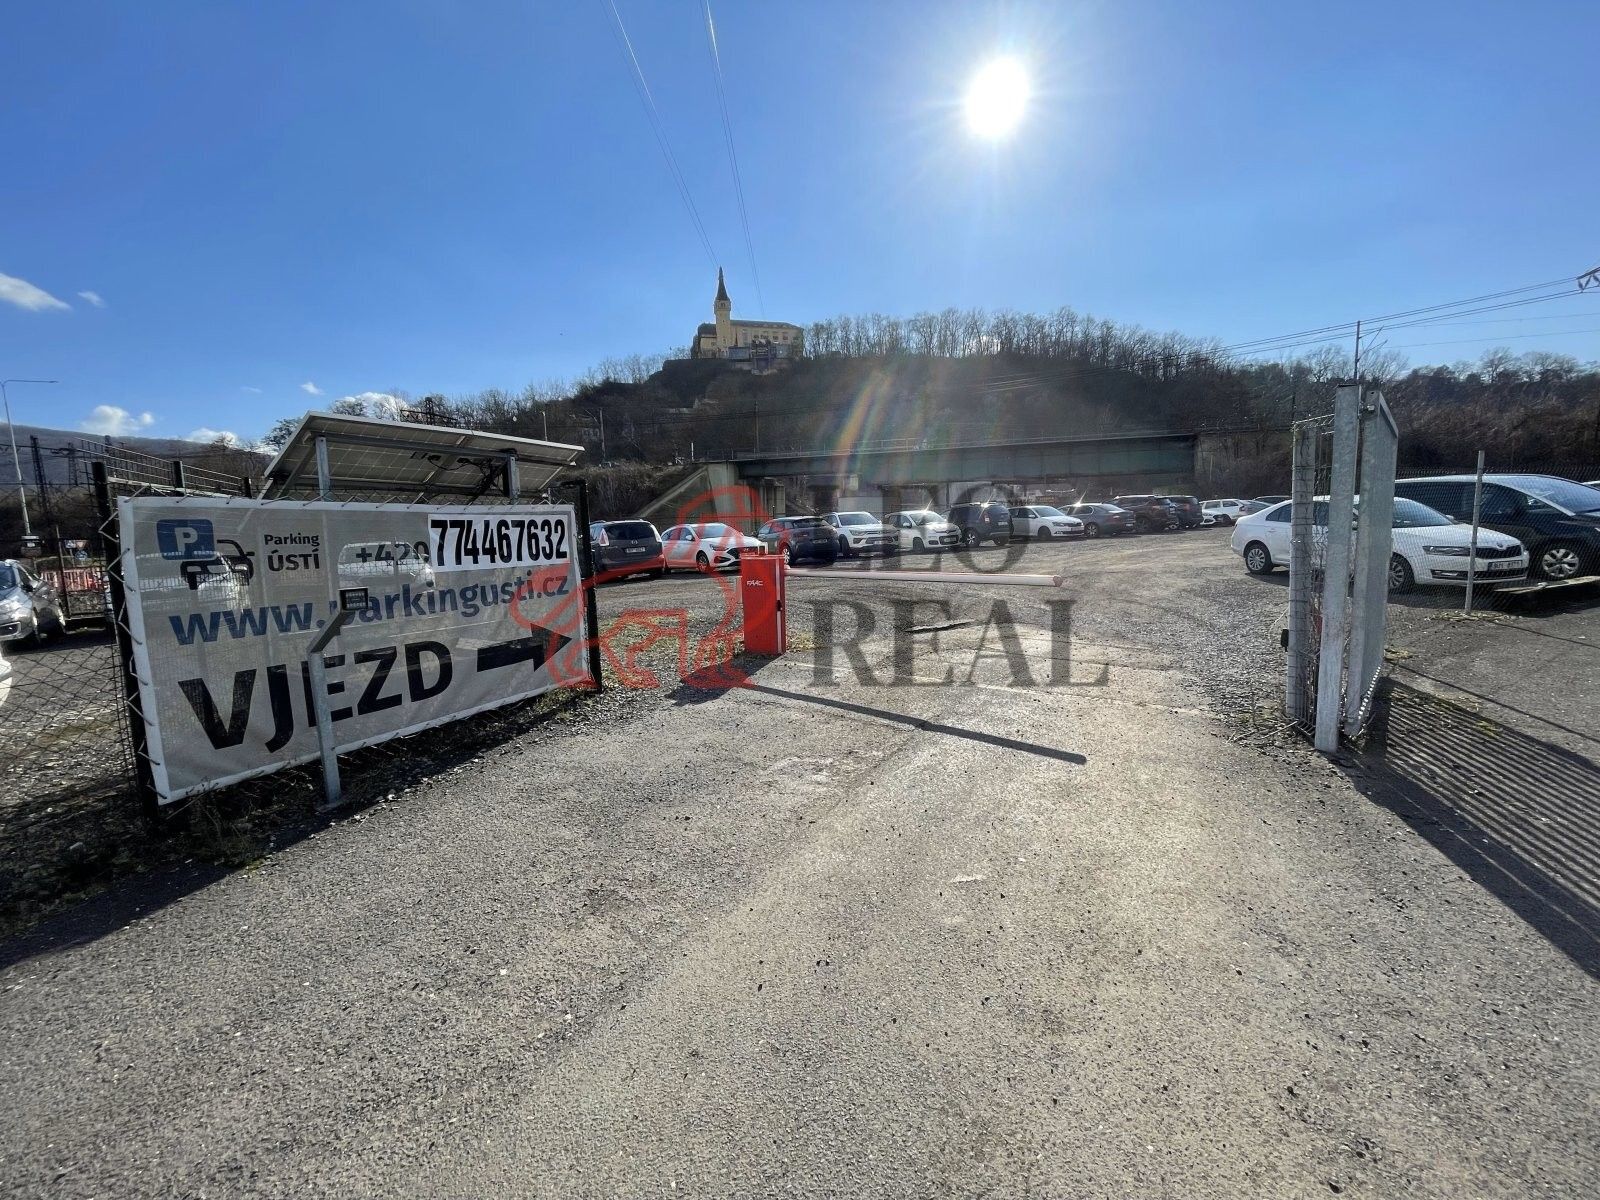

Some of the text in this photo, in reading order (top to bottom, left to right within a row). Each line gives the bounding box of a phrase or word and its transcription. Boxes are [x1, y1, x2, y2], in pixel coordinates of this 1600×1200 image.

[174, 527, 198, 555] P
[264, 532, 320, 547] Parking
[430, 518, 568, 567] 774467632
[267, 548, 320, 572] ÚSTÍ
[178, 640, 453, 754] VJEZD
